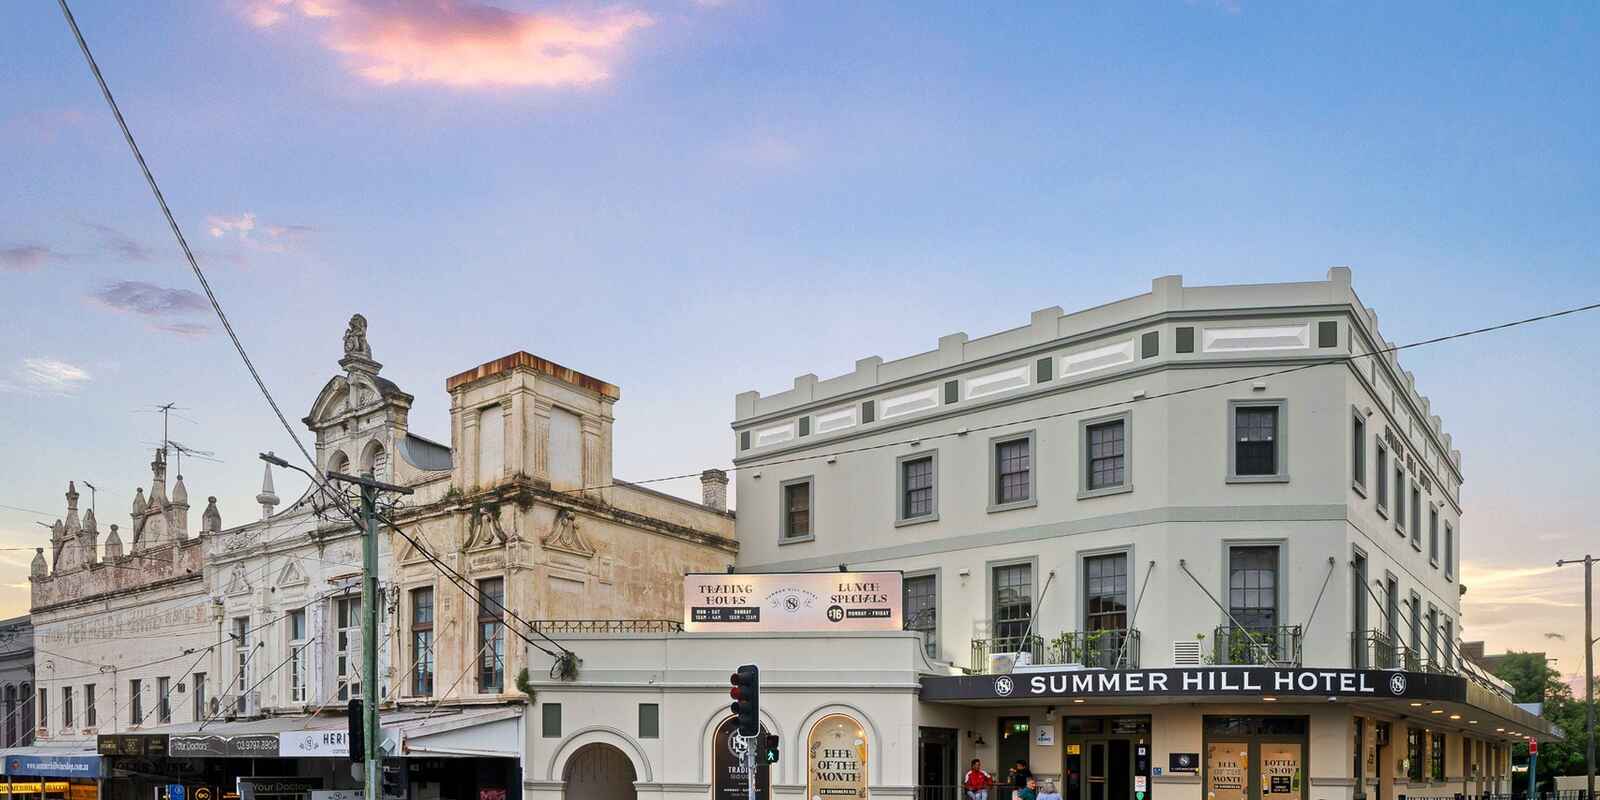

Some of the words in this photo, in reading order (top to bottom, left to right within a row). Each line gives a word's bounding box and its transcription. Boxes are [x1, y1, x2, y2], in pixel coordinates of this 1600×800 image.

[698, 584, 753, 594] TRADING
[838, 583, 880, 593] LUNCH
[705, 596, 746, 605] HOURS
[830, 594, 888, 604] SPECIALS
[828, 608, 842, 619] $16
[1030, 672, 1169, 694] SUMMER
[1182, 671, 1261, 691] HILL
[1274, 671, 1375, 692] HOTEL
[823, 749, 856, 759] BEER
[817, 760, 834, 770] OF
[835, 760, 858, 770] THE
[1269, 767, 1294, 775] SHOP
[816, 772, 860, 782] MONTH
[254, 783, 273, 791] Your
[276, 783, 313, 791] Doctors
